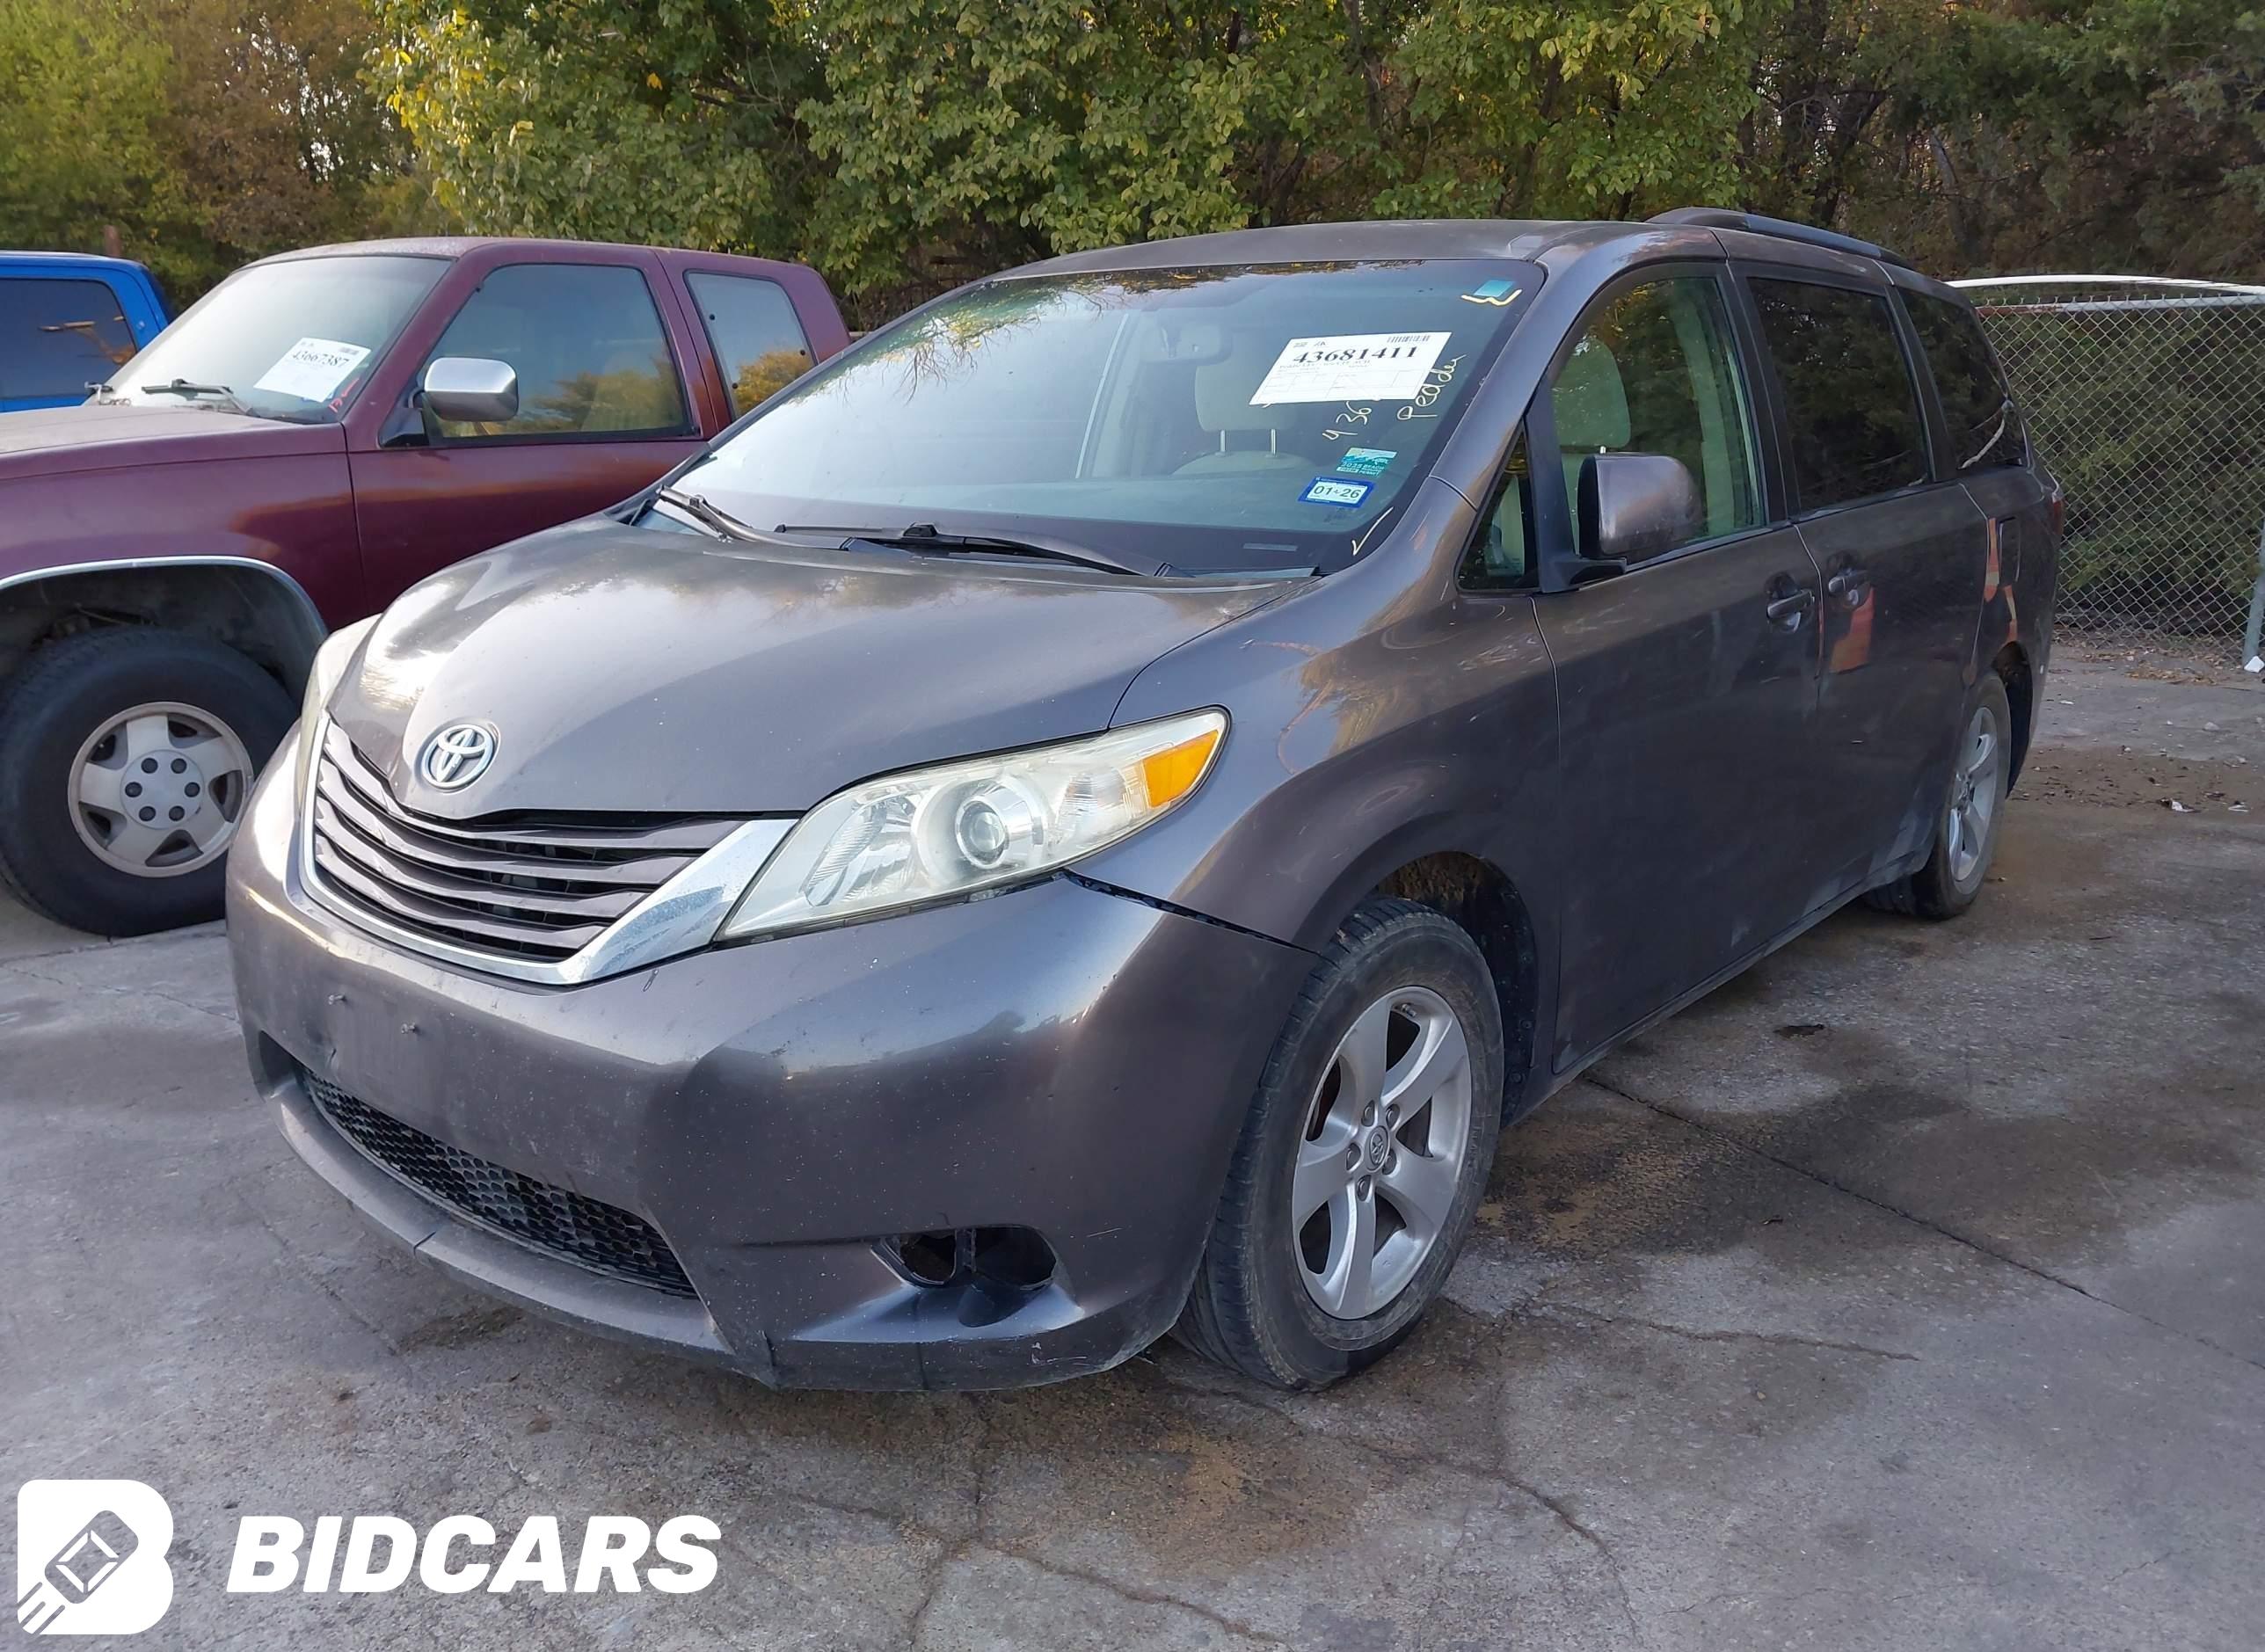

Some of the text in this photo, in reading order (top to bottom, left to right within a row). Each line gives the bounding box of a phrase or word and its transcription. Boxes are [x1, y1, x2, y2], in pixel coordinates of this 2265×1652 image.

[292, 351, 350, 368] 43667387
[1293, 346, 1418, 363] 43681411
[1314, 485, 1362, 499] 01 26
